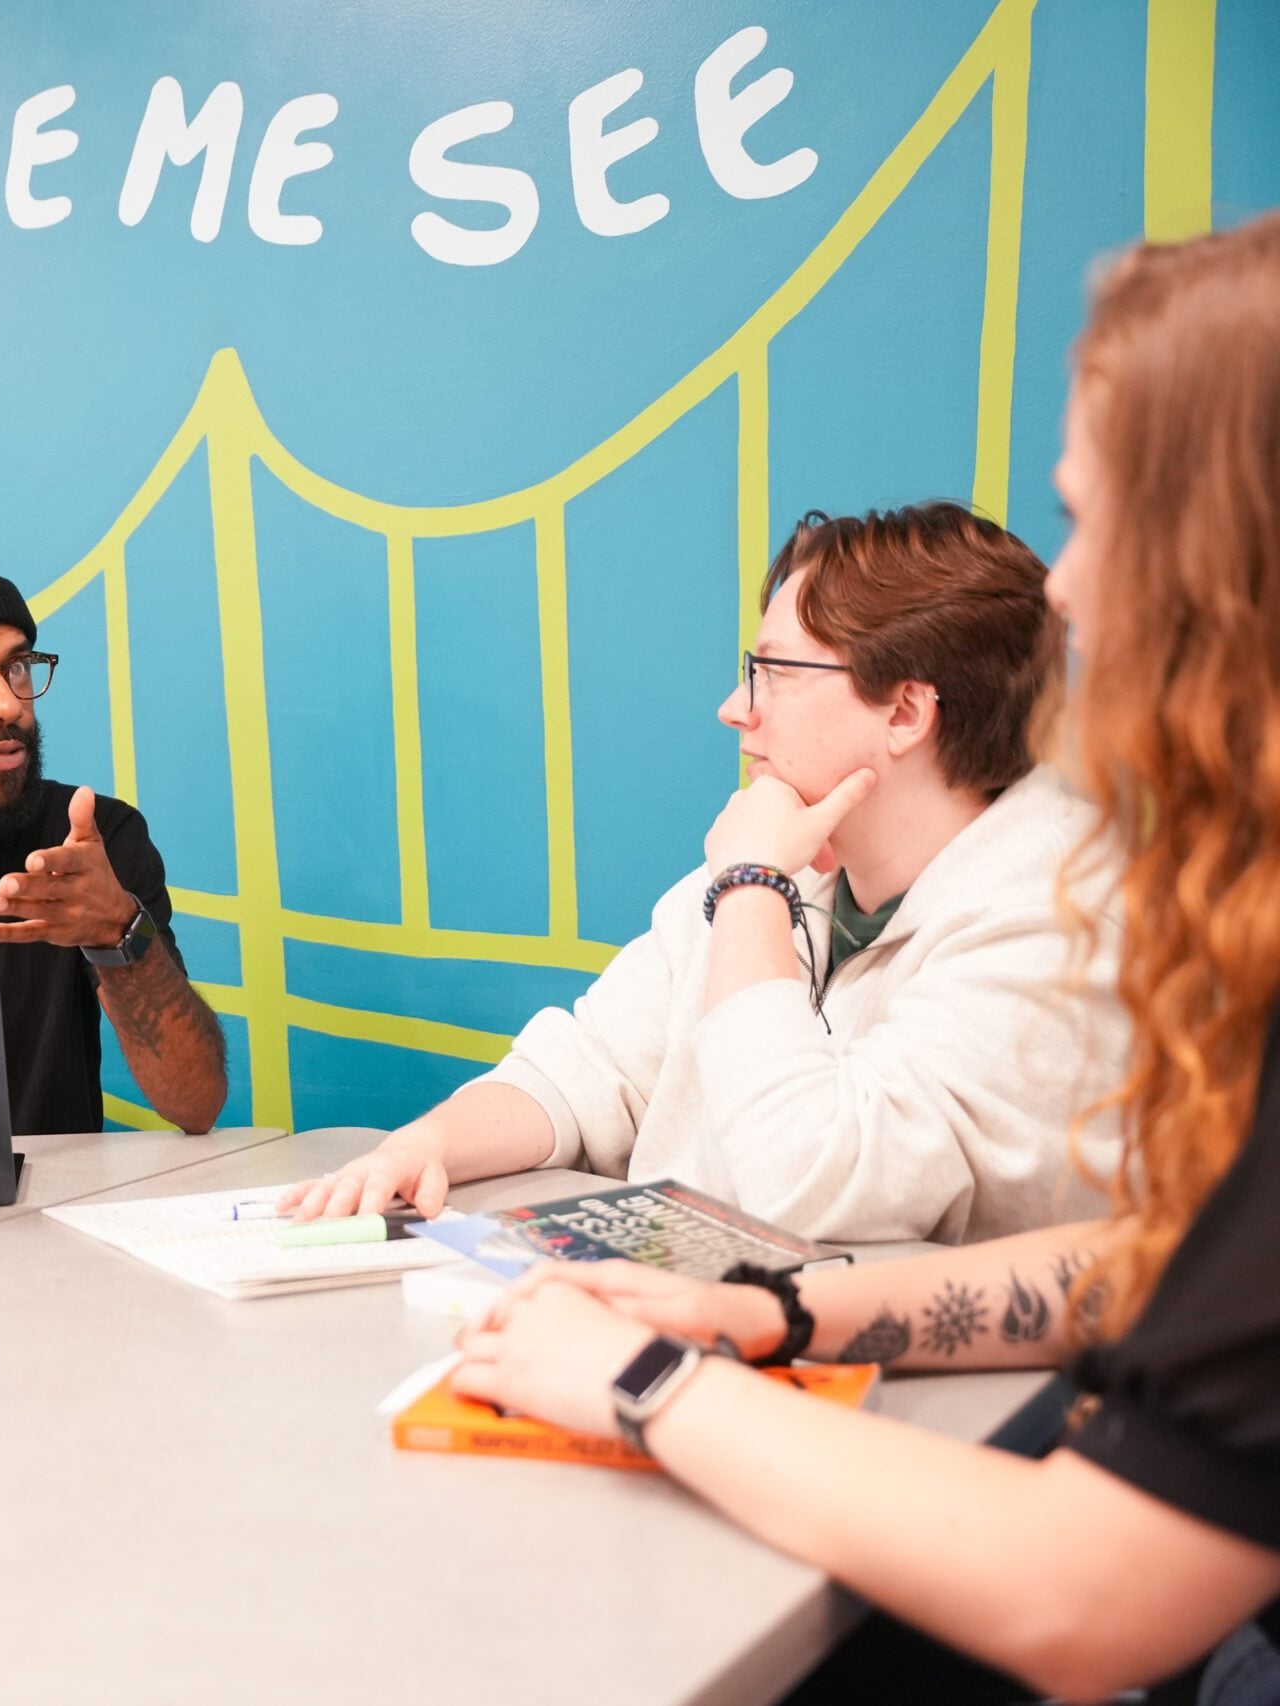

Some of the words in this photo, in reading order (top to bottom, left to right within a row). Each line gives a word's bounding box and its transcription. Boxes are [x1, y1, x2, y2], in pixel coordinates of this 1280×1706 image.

[119, 76, 338, 245] ME
[409, 26, 818, 266] SEE
[578, 1199, 628, 1220] AND
